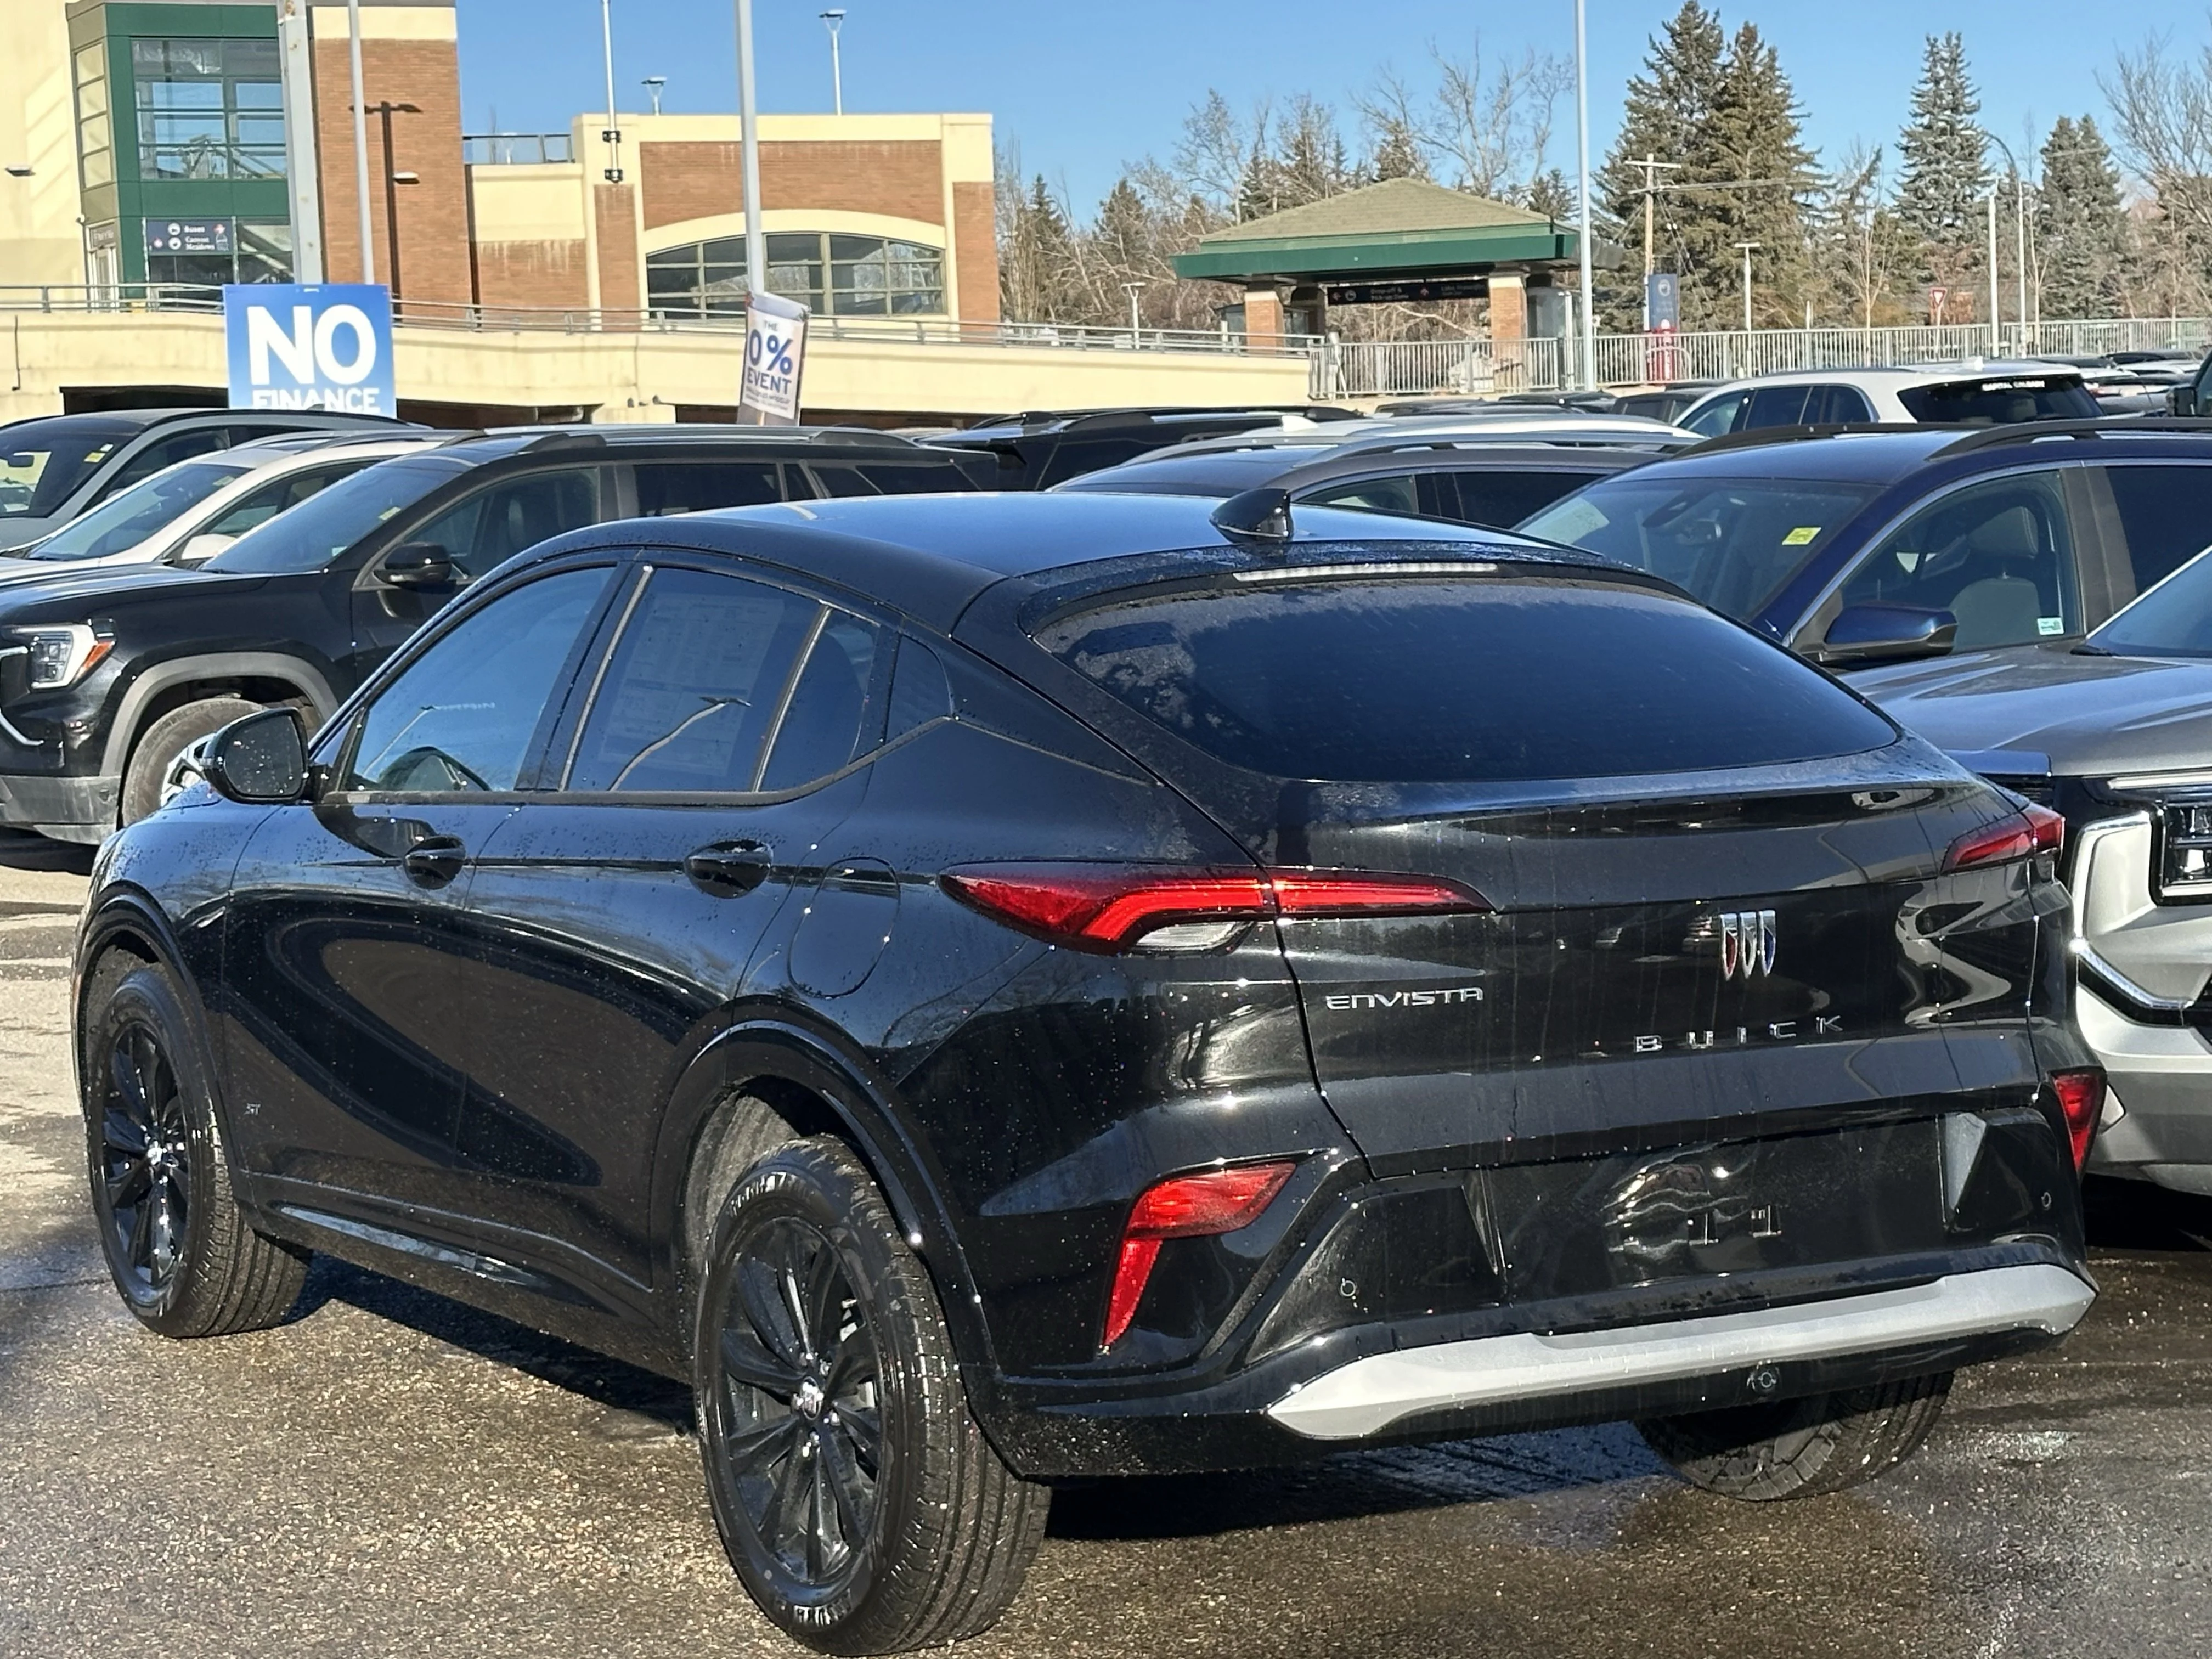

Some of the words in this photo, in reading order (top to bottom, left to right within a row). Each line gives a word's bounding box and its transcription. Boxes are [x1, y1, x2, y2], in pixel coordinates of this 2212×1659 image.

[763, 320, 778, 332] THE
[247, 304, 377, 385] NO
[749, 329, 794, 376] 0%
[747, 366, 792, 395] EVENT
[252, 387, 381, 412] FINANCE
[1325, 987, 1483, 1009] ENVISTA
[1634, 1015, 1843, 1053] BUICK
